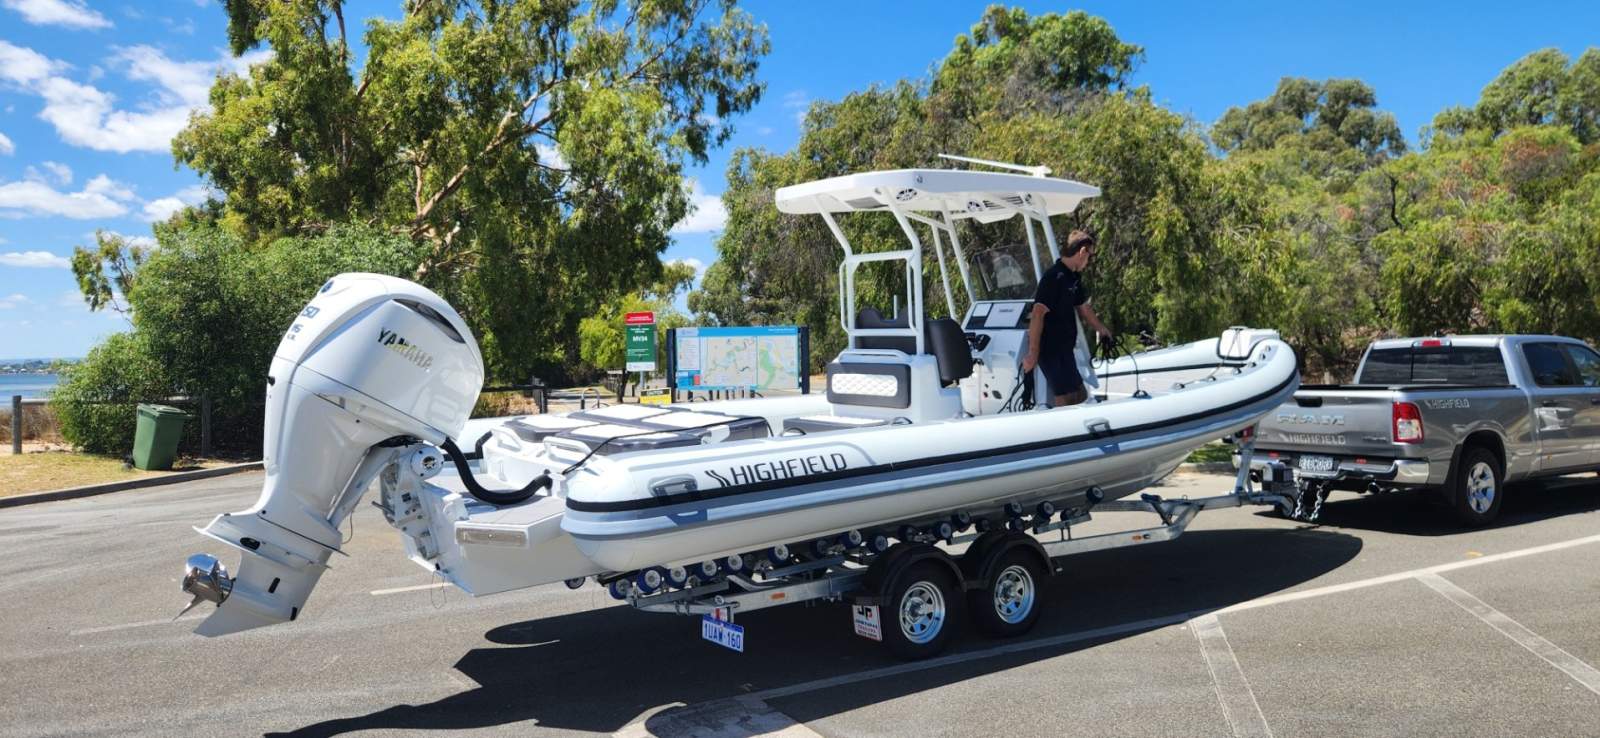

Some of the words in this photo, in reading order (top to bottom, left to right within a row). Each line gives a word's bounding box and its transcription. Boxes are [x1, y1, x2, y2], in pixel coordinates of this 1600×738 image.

[377, 327, 433, 368] YAMAHA
[1431, 398, 1470, 409] HIGHFIELD
[1277, 414, 1345, 426] RAM
[1289, 432, 1346, 445] HIGHFIELD
[730, 452, 848, 485] HIGHFIELD
